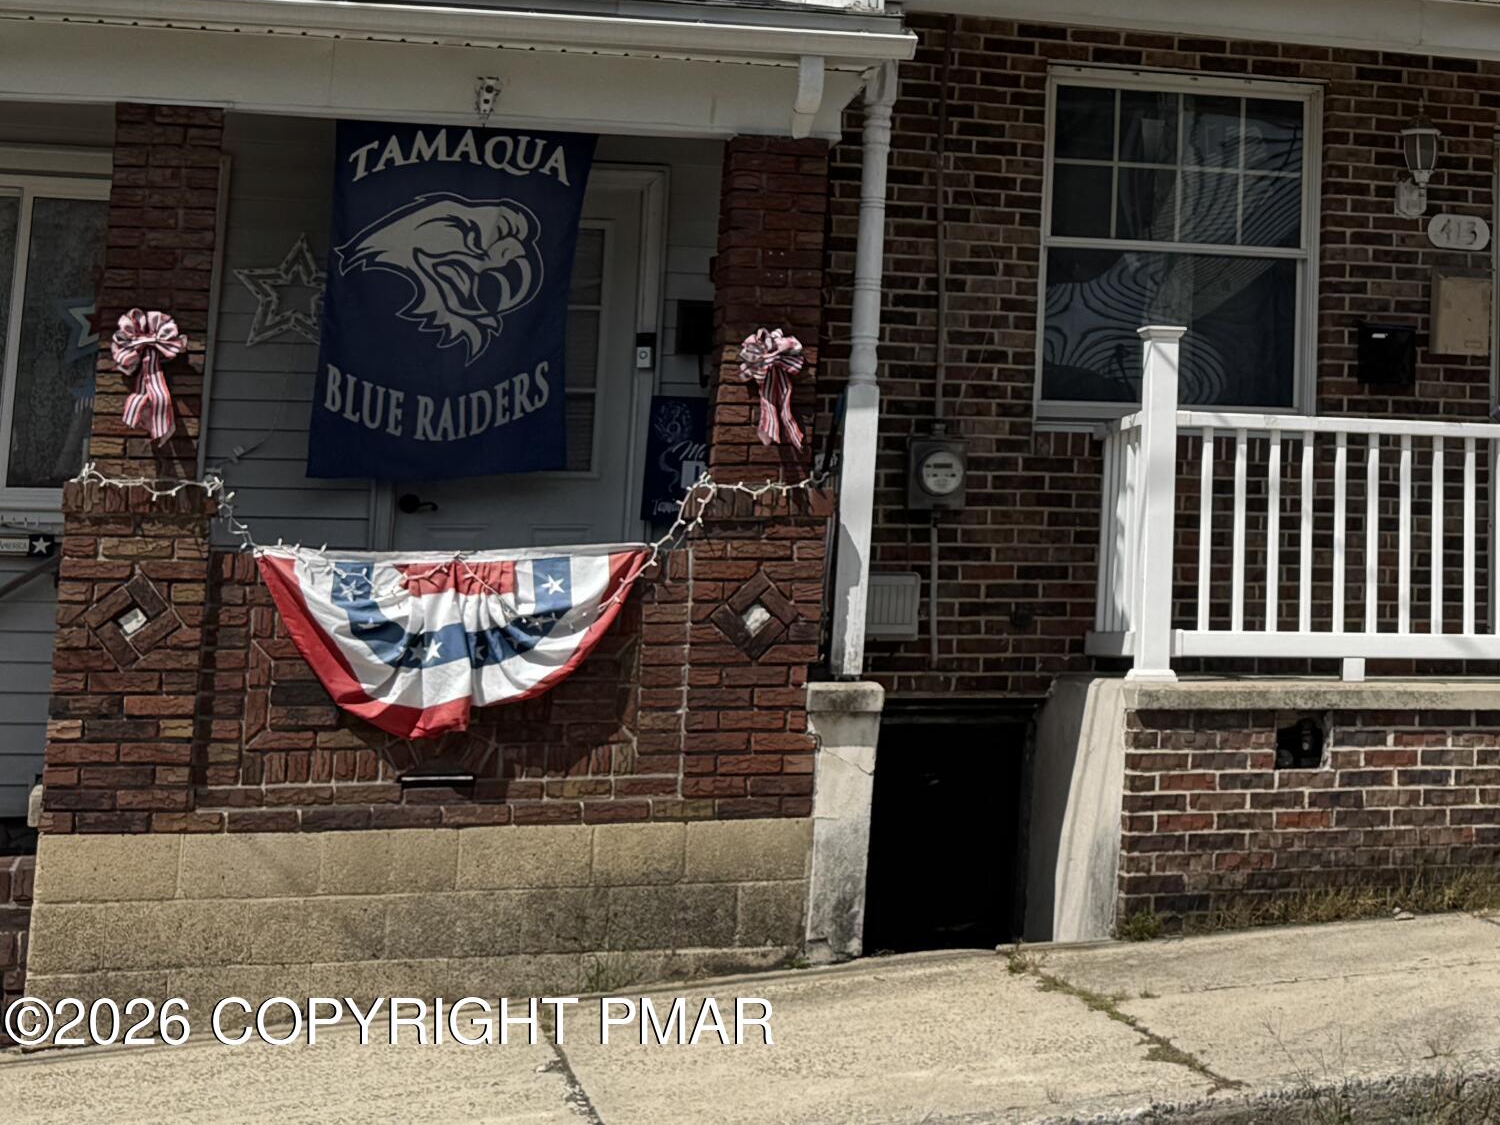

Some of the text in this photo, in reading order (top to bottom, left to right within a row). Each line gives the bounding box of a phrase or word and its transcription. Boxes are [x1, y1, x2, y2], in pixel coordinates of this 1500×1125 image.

[348, 128, 570, 187] TAMAQUA
[324, 361, 550, 442] BLUE RAIDERS
